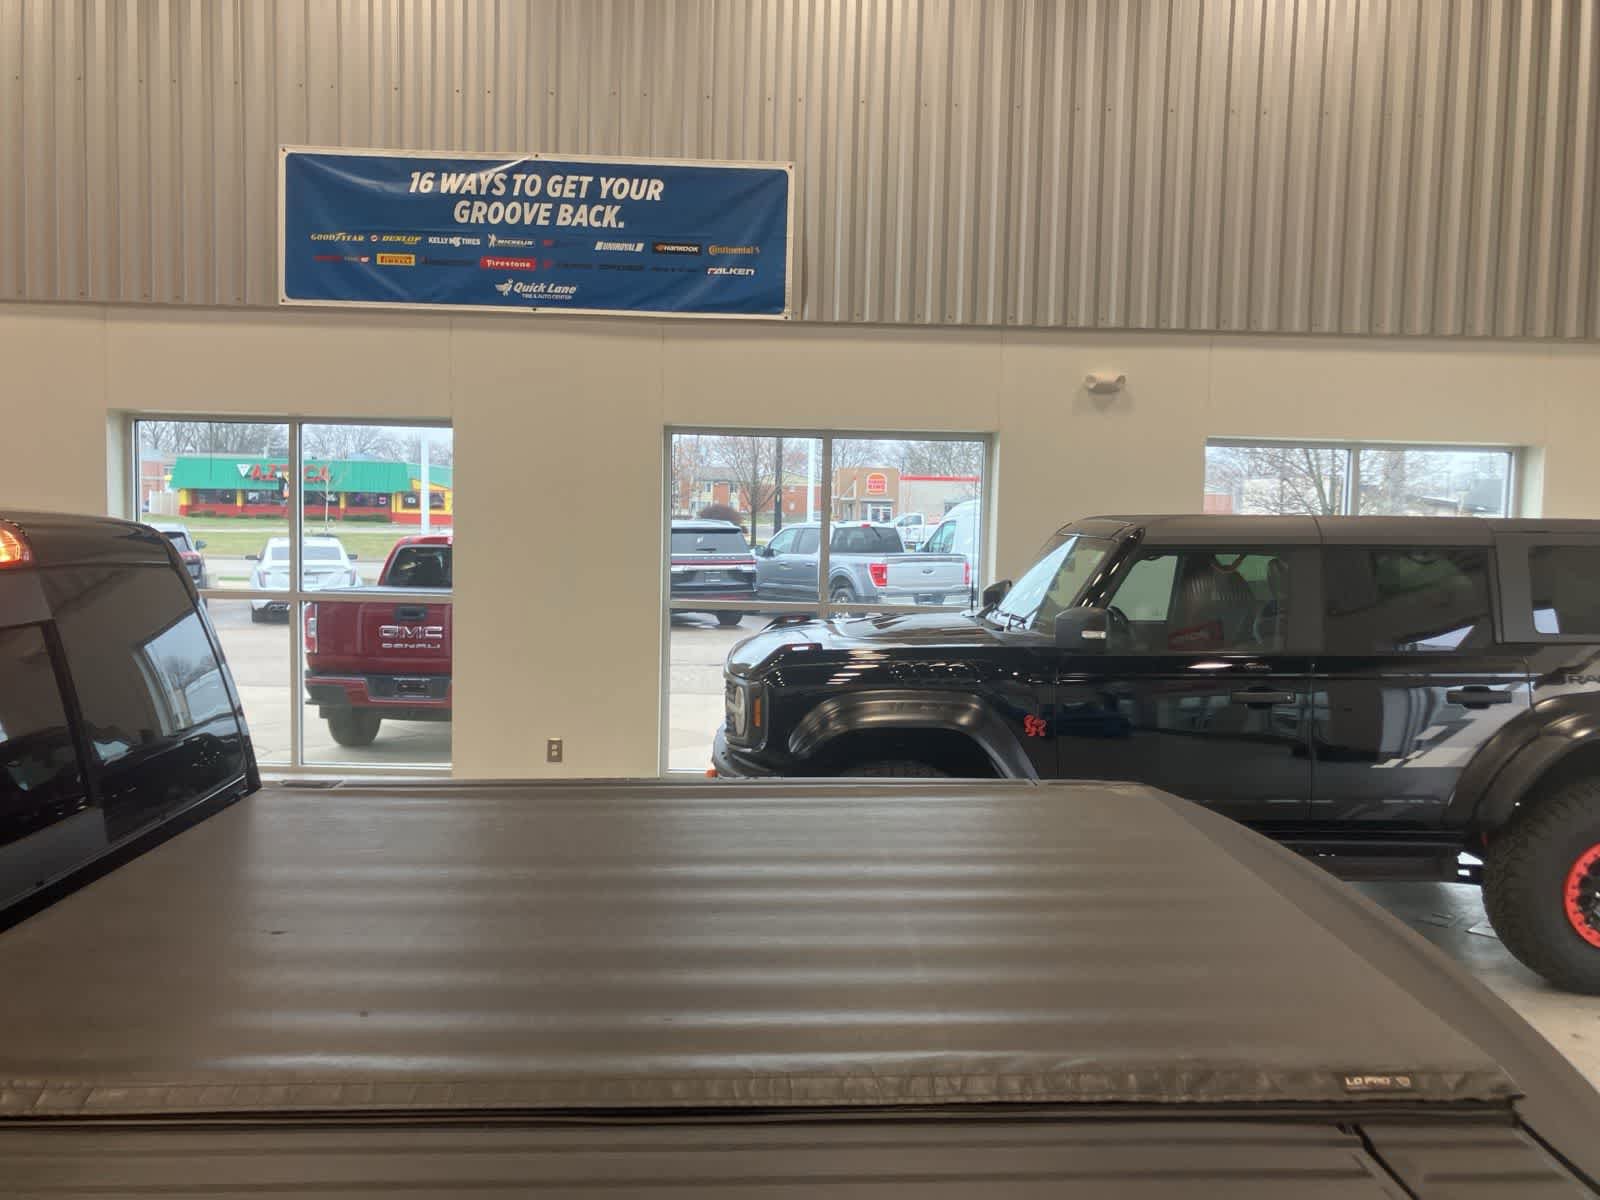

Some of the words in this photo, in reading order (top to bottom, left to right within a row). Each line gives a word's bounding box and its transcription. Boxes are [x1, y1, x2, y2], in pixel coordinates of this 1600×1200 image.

[409, 171, 435, 193] 16
[440, 172, 507, 197] WAYS
[512, 174, 542, 197] TO
[547, 175, 594, 199] GET
[599, 176, 665, 201] YOUR
[453, 200, 553, 226] GROOVE
[556, 203, 625, 229] BACK.
[428, 236, 450, 244] KELLY
[486, 258, 531, 268] Firestone
[513, 281, 546, 293] Quick
[547, 283, 577, 294] Lane
[379, 625, 443, 639] GMC
